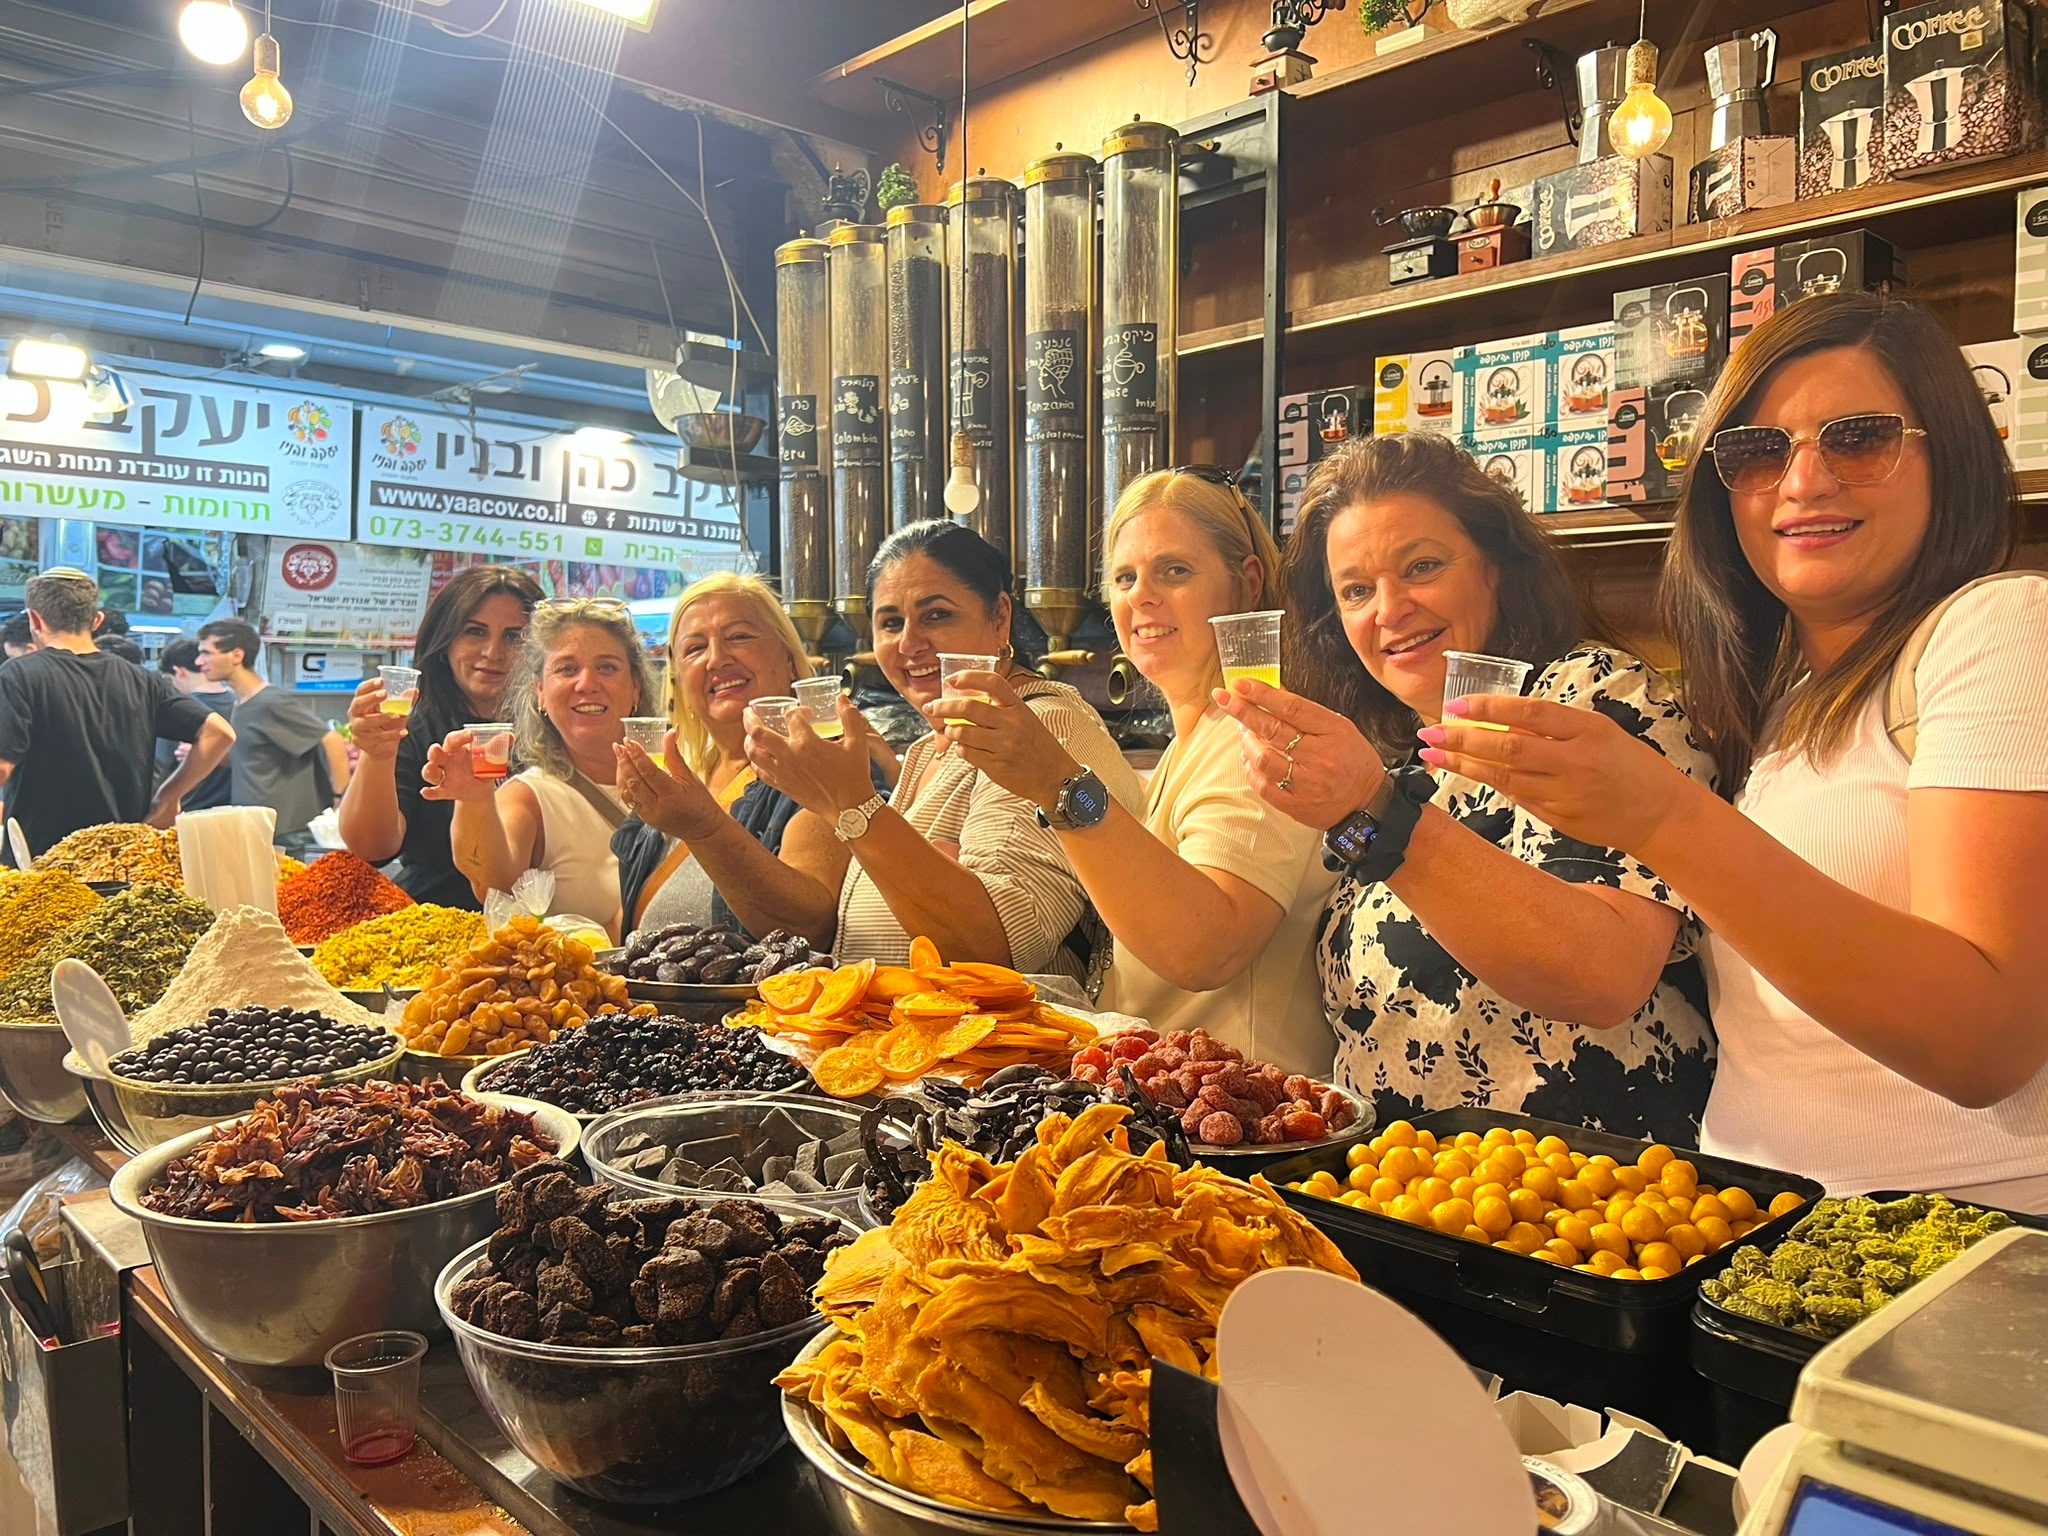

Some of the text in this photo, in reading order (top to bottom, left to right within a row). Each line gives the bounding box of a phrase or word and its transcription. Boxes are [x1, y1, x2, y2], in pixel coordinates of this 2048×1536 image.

[1891, 6, 1990, 50] COFFEE
[1026, 400, 1075, 414] Tanzania
[1135, 398, 1156, 408] mix
[833, 431, 878, 446] Colombia
[57, 453, 112, 473] תחת
[435, 431, 543, 482] ובניו
[118, 459, 190, 480] עובדת
[195, 466, 214, 482] זו
[218, 469, 268, 488] חנות
[162, 494, 271, 522] תרומות
[377, 485, 568, 524] www.yaacov.co.il
[369, 514, 564, 553] 073-3744-551
[627, 514, 699, 537] ברשתות
[623, 541, 676, 563] הבית
